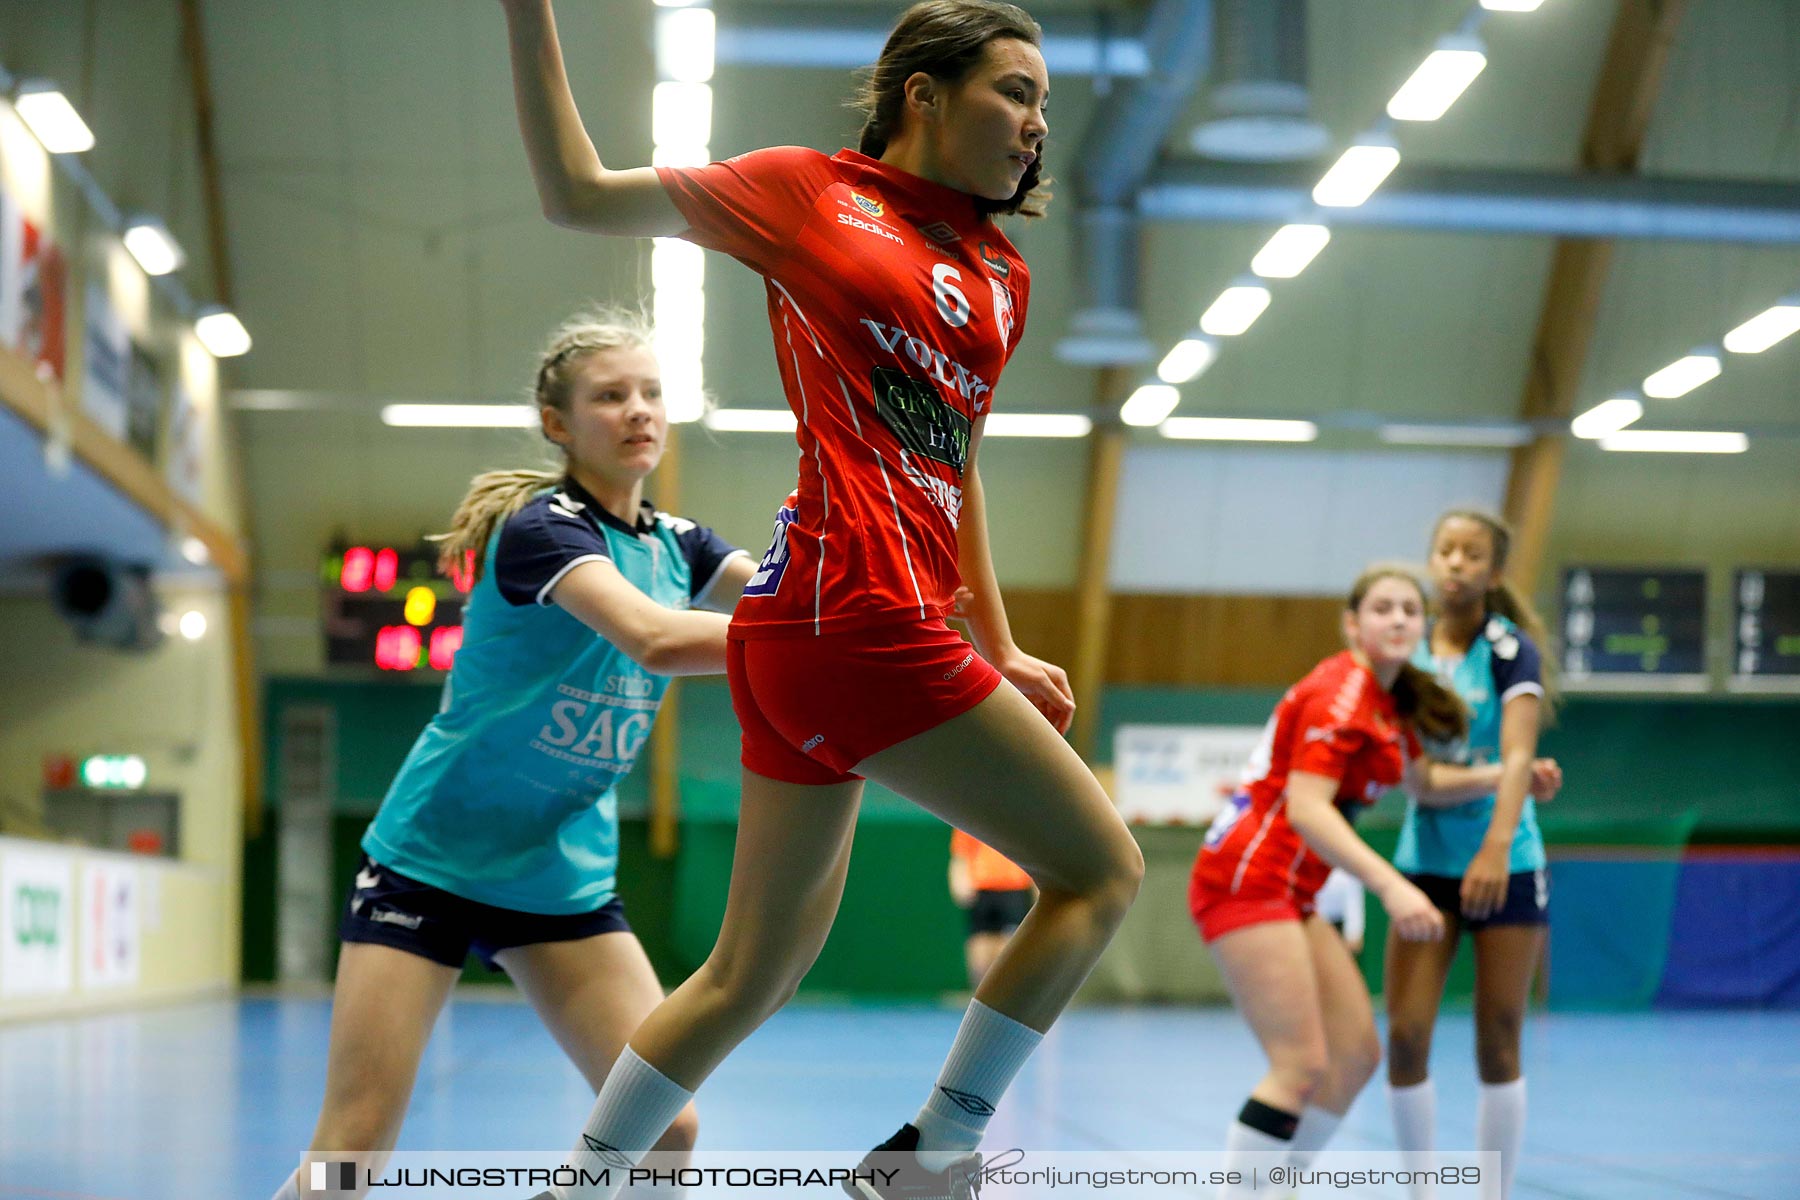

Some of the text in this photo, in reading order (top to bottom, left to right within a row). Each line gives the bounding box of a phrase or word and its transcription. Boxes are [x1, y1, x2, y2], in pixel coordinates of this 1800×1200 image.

[837, 213, 904, 246] stadium
[931, 263, 970, 328] 6
[943, 653, 975, 681] QUICKDRY
